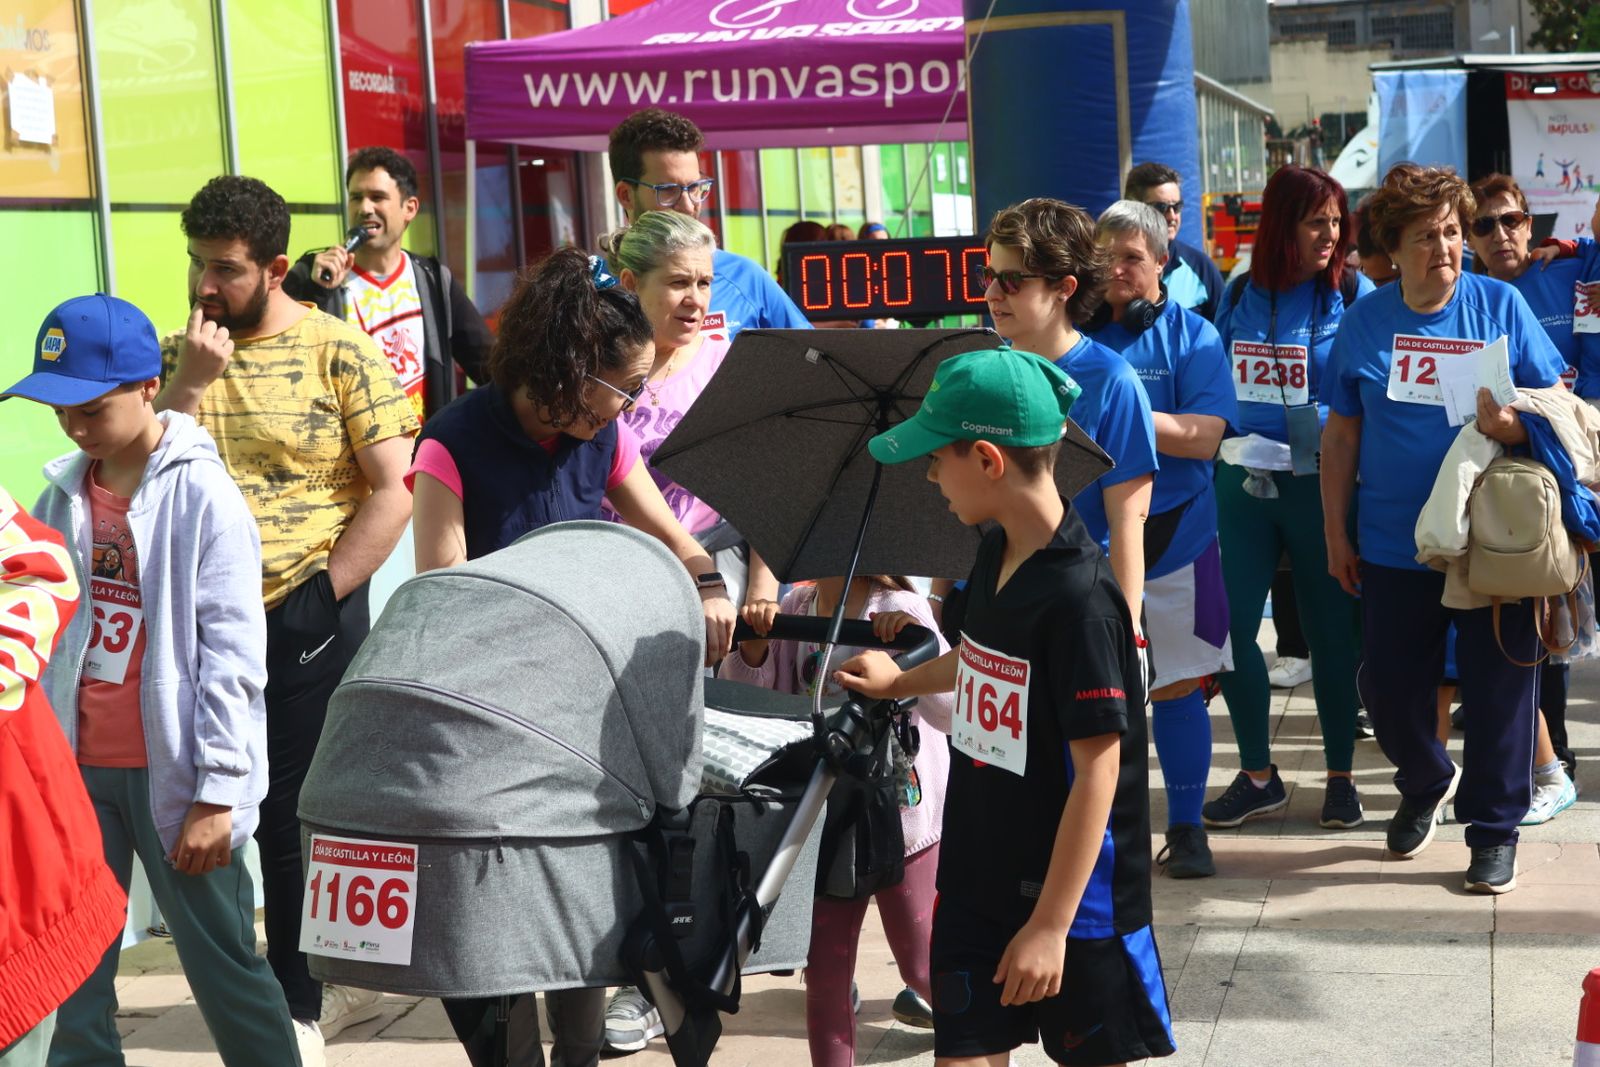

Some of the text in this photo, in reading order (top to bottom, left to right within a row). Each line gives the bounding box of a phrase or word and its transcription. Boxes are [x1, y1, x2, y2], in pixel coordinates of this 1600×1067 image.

[1568, 76, 1592, 91] CA
[1422, 342, 1454, 351] CASTILLA
[1236, 359, 1306, 389] 1238
[1397, 354, 1440, 386] 12
[961, 420, 1013, 436] Cognizant
[114, 589, 139, 602] LEÓN
[88, 606, 134, 654] 63
[956, 668, 1022, 740] 1164
[332, 848, 370, 861] CASTILLA
[372, 852, 379, 861] Y
[381, 851, 411, 864] LEÓN
[309, 870, 410, 929] 1166
